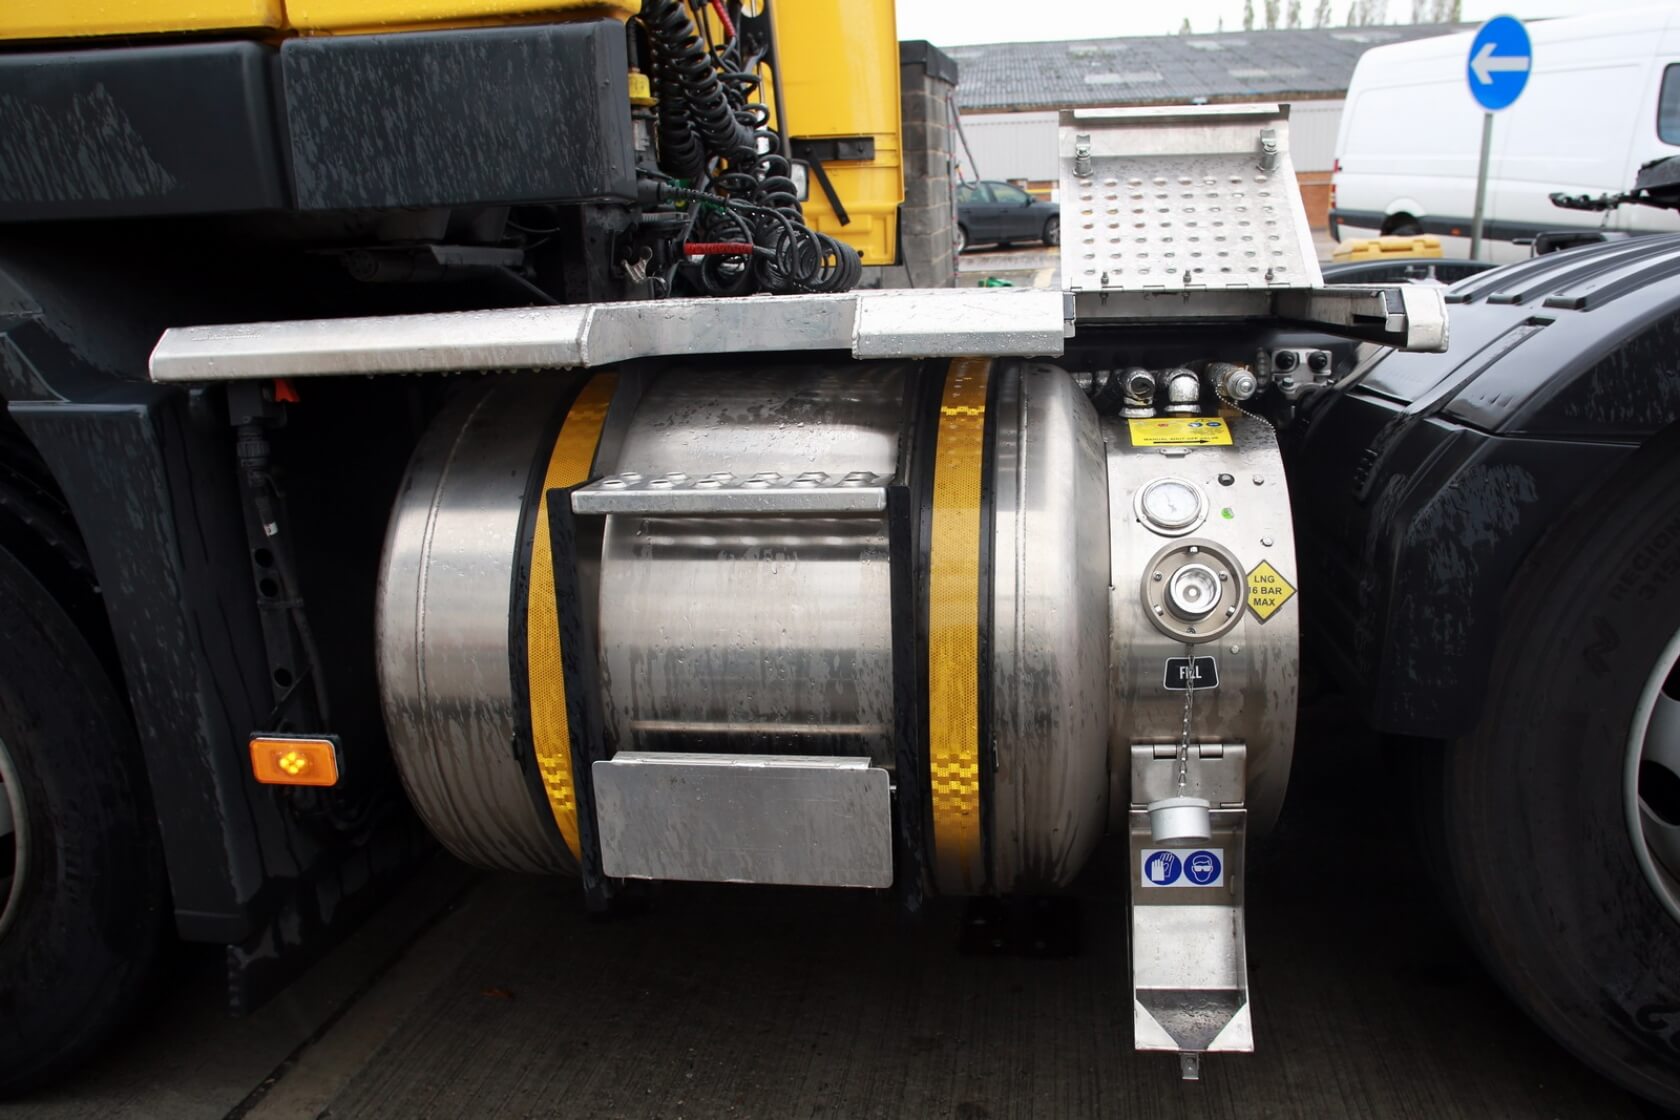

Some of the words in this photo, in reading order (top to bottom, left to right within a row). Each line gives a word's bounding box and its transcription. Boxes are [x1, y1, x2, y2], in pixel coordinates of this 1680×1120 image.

[1254, 575, 1275, 584] LNG
[1261, 586, 1282, 595] BAR
[1253, 597, 1276, 606] MAX
[1179, 665, 1203, 680] FILL
